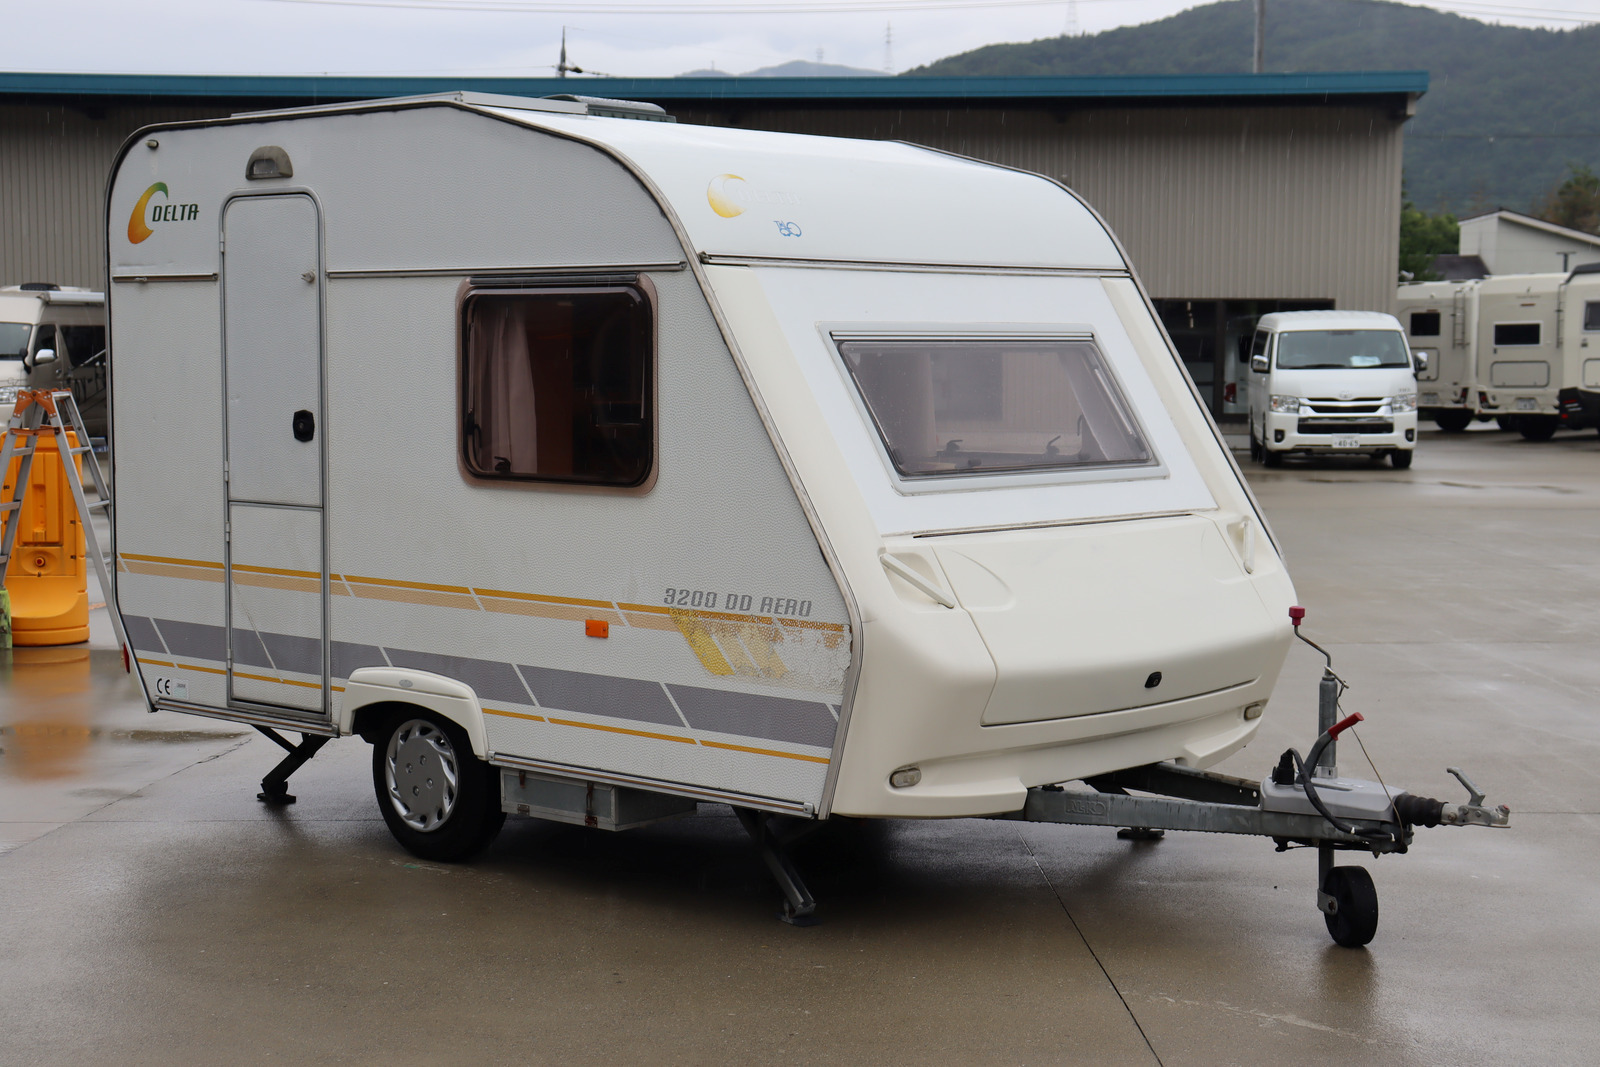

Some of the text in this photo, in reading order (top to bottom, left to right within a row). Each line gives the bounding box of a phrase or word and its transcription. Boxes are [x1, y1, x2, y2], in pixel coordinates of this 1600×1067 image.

[152, 204, 199, 221] DELTA
[664, 588, 718, 609] 3200
[760, 597, 812, 617] AERO
[157, 678, 170, 695] CE
